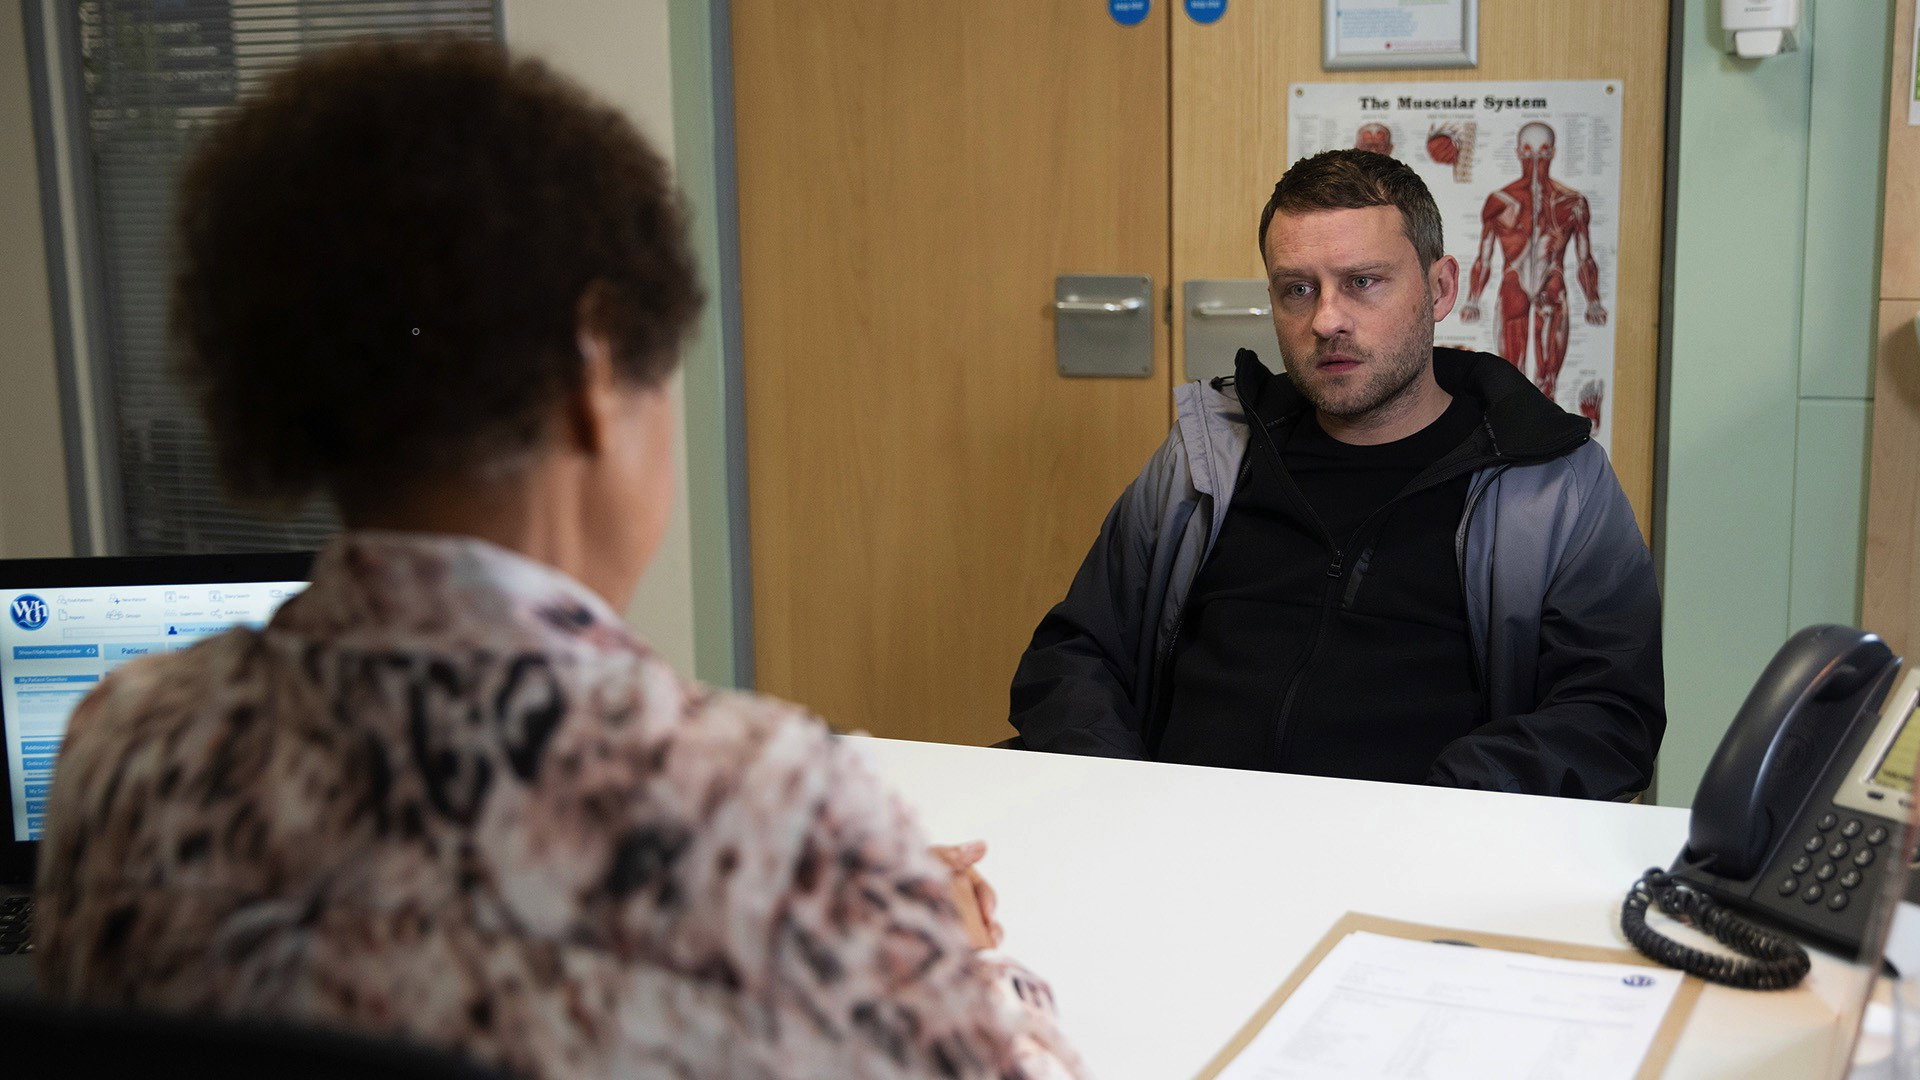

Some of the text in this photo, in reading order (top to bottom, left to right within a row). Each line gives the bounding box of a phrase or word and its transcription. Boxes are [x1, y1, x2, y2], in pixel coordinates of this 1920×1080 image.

[1359, 95, 1547, 113] The Muscular System
[121, 647, 149, 655] Patient
